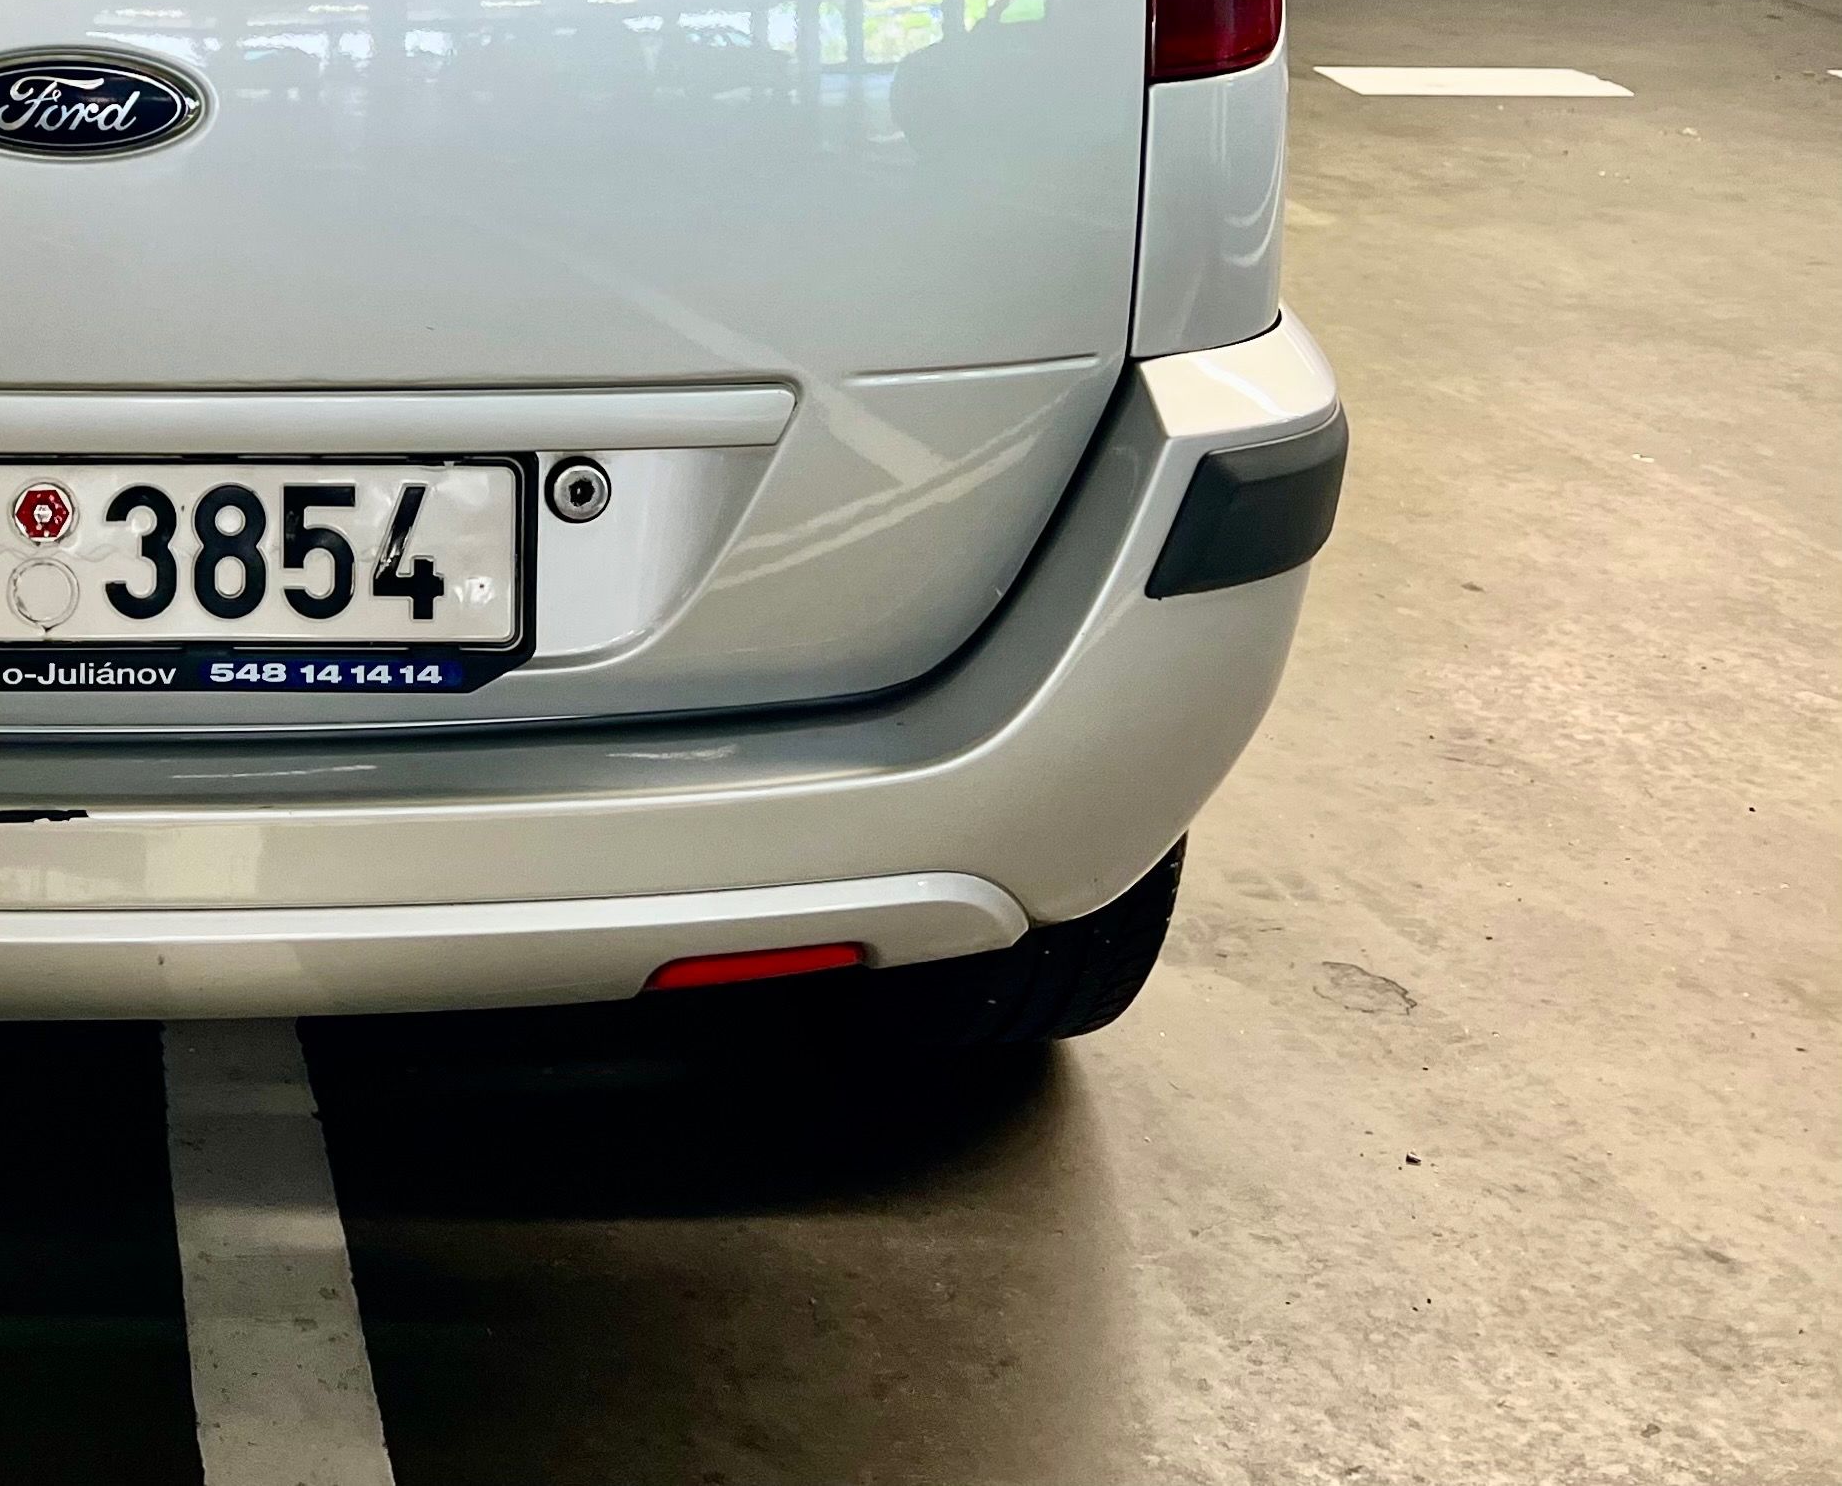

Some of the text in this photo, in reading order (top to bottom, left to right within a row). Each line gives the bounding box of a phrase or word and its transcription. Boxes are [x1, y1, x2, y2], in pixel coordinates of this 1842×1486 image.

[105, 484, 445, 620] 3854
[210, 663, 287, 682] 548
[300, 664, 342, 683] 14
[350, 665, 392, 683] 14
[399, 665, 442, 683] 14
